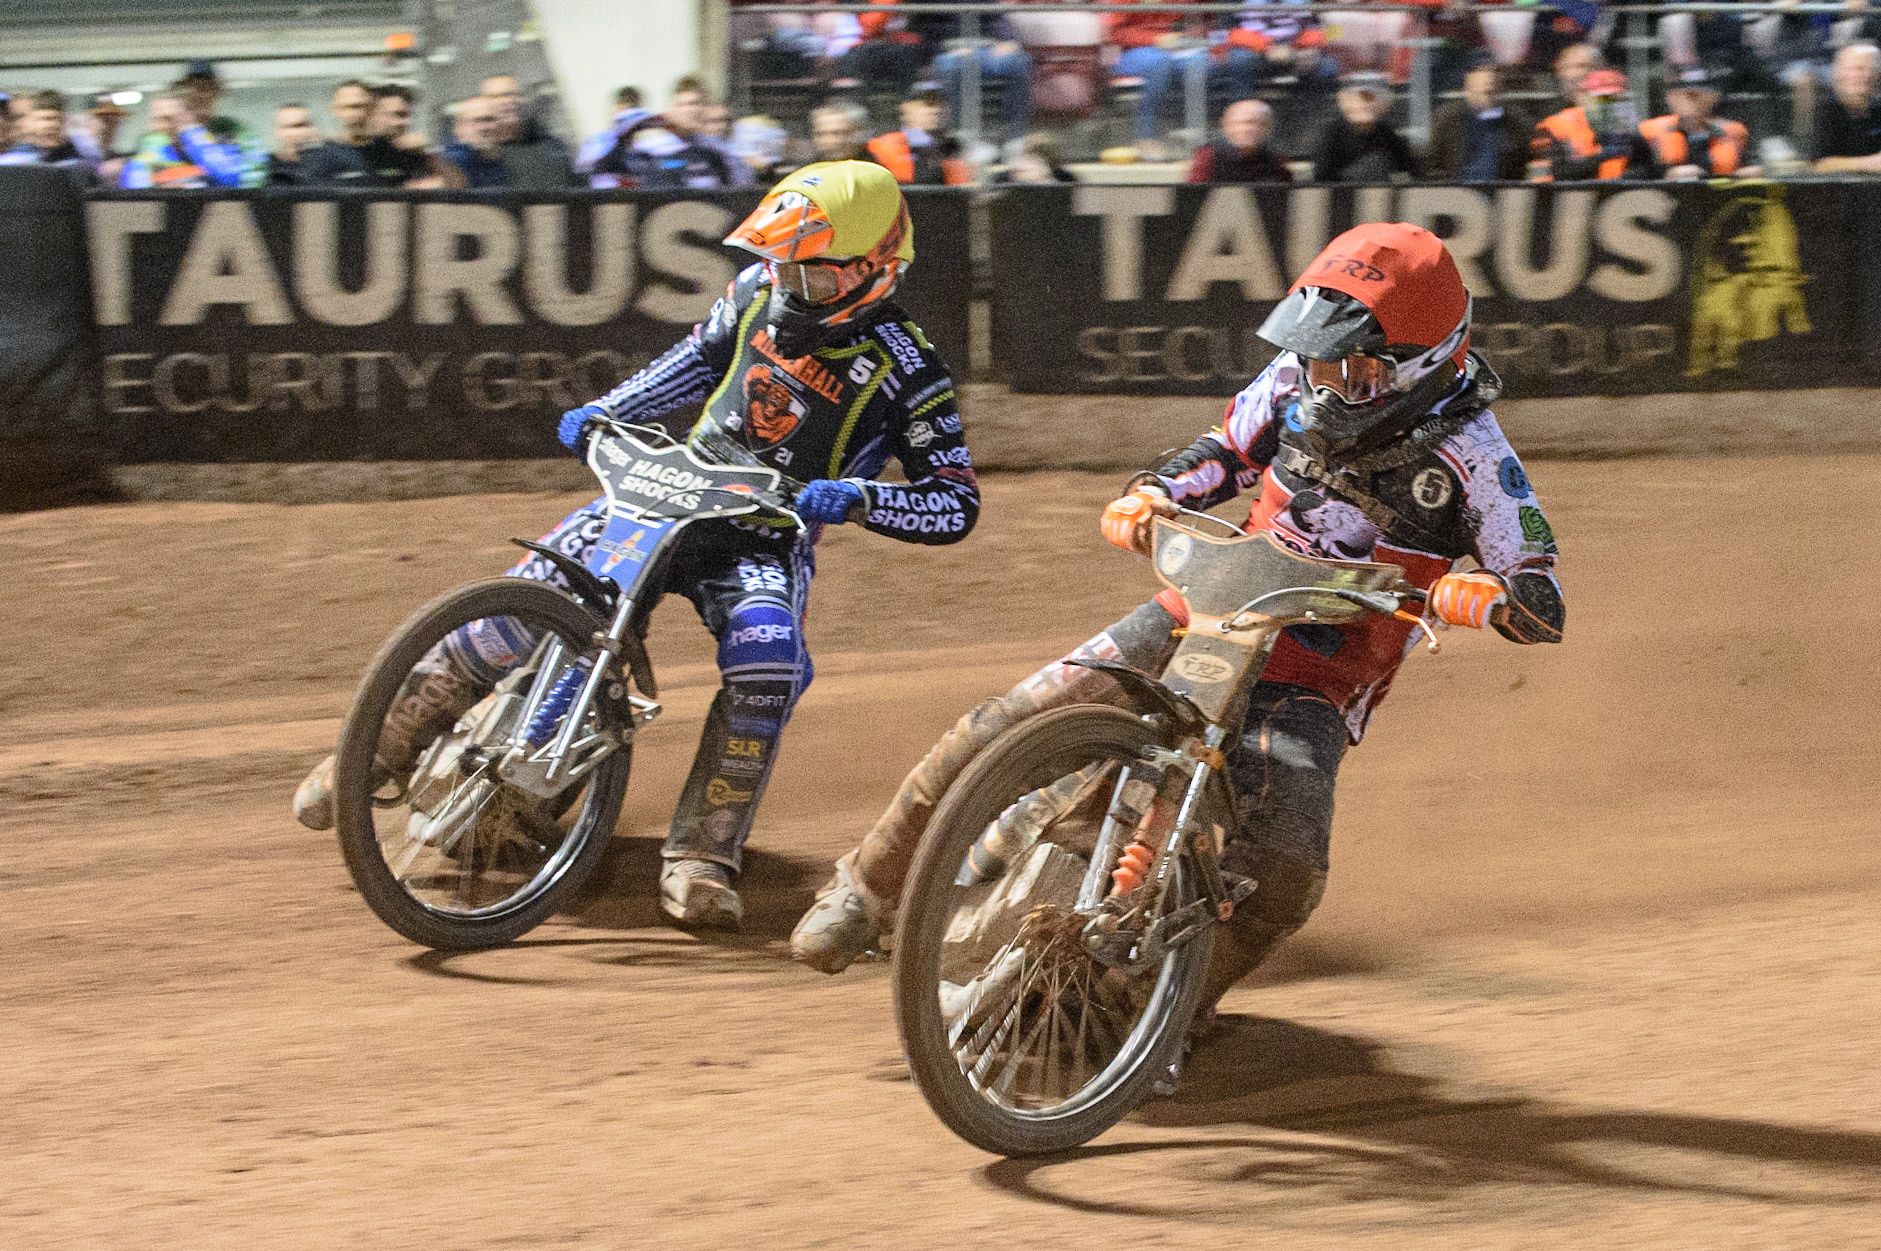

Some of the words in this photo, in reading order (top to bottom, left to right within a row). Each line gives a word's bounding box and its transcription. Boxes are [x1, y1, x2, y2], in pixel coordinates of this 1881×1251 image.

[85, 200, 738, 327] TAURUS
[884, 321, 927, 369] HAGON
[847, 355, 877, 385] 5
[618, 474, 702, 511] SHOCKS
[627, 458, 714, 495] HAGON
[876, 485, 963, 513] HAGON
[867, 508, 966, 533] SHOCKS
[726, 738, 761, 758] SLR
